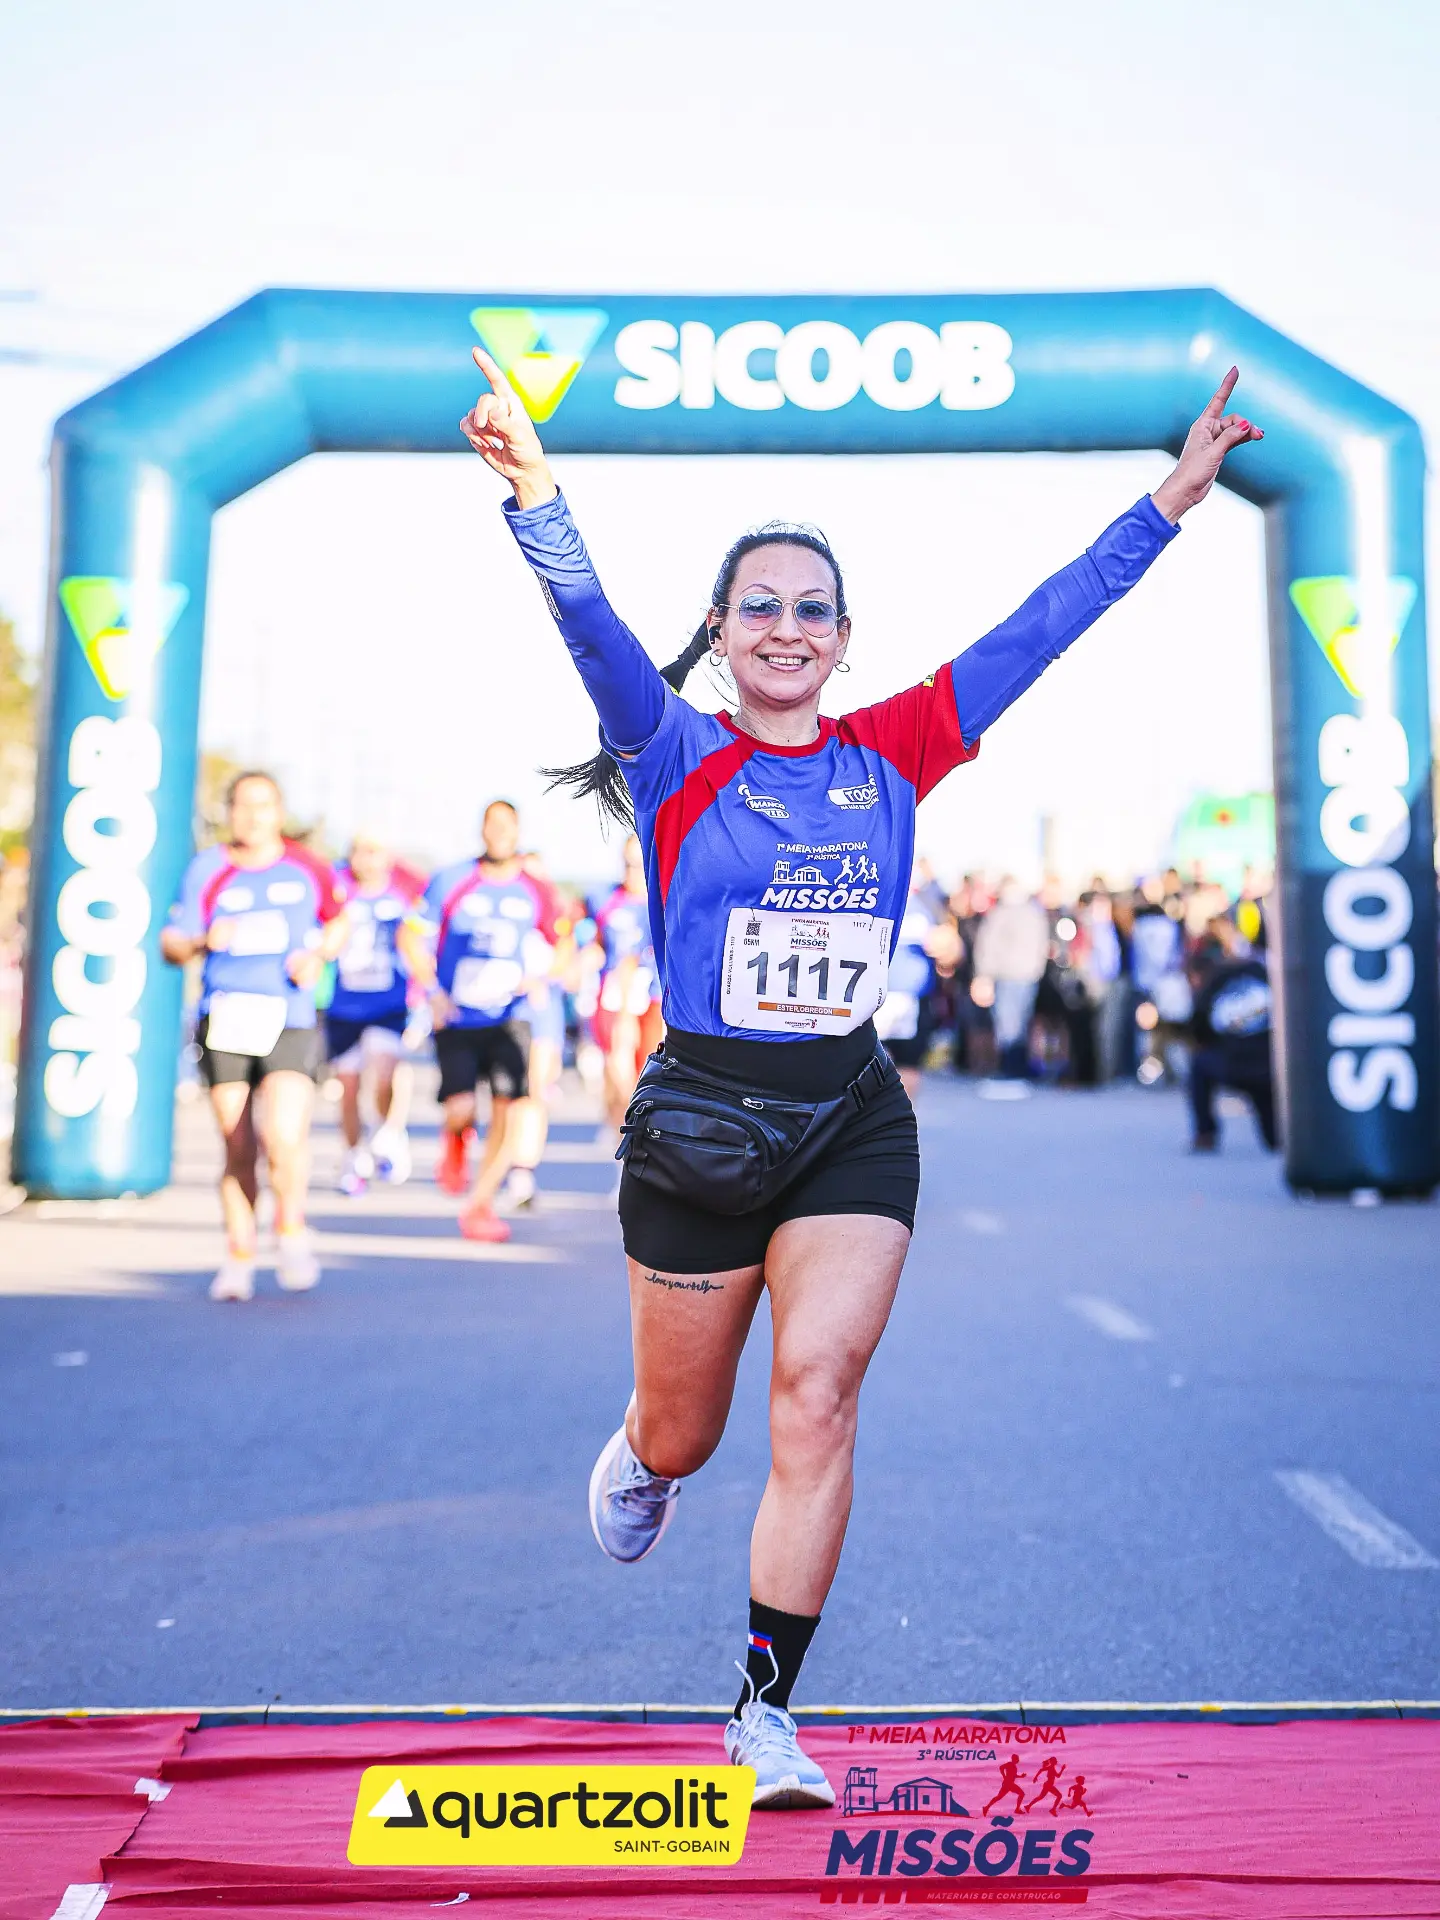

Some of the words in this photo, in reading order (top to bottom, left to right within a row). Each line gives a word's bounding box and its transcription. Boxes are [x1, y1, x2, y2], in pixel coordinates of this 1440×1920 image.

[614, 320, 1016, 411] SICOOB
[786, 843, 812, 854] MEIA
[812, 841, 869, 853] MARATONA
[760, 883, 880, 910] MISSÕES
[1318, 714, 1418, 1112] SICOOB
[44, 715, 162, 1119] SICOOB
[790, 937, 828, 947] MISSÕES
[747, 951, 868, 1003] 1117
[776, 1003, 800, 1013] ESTER
